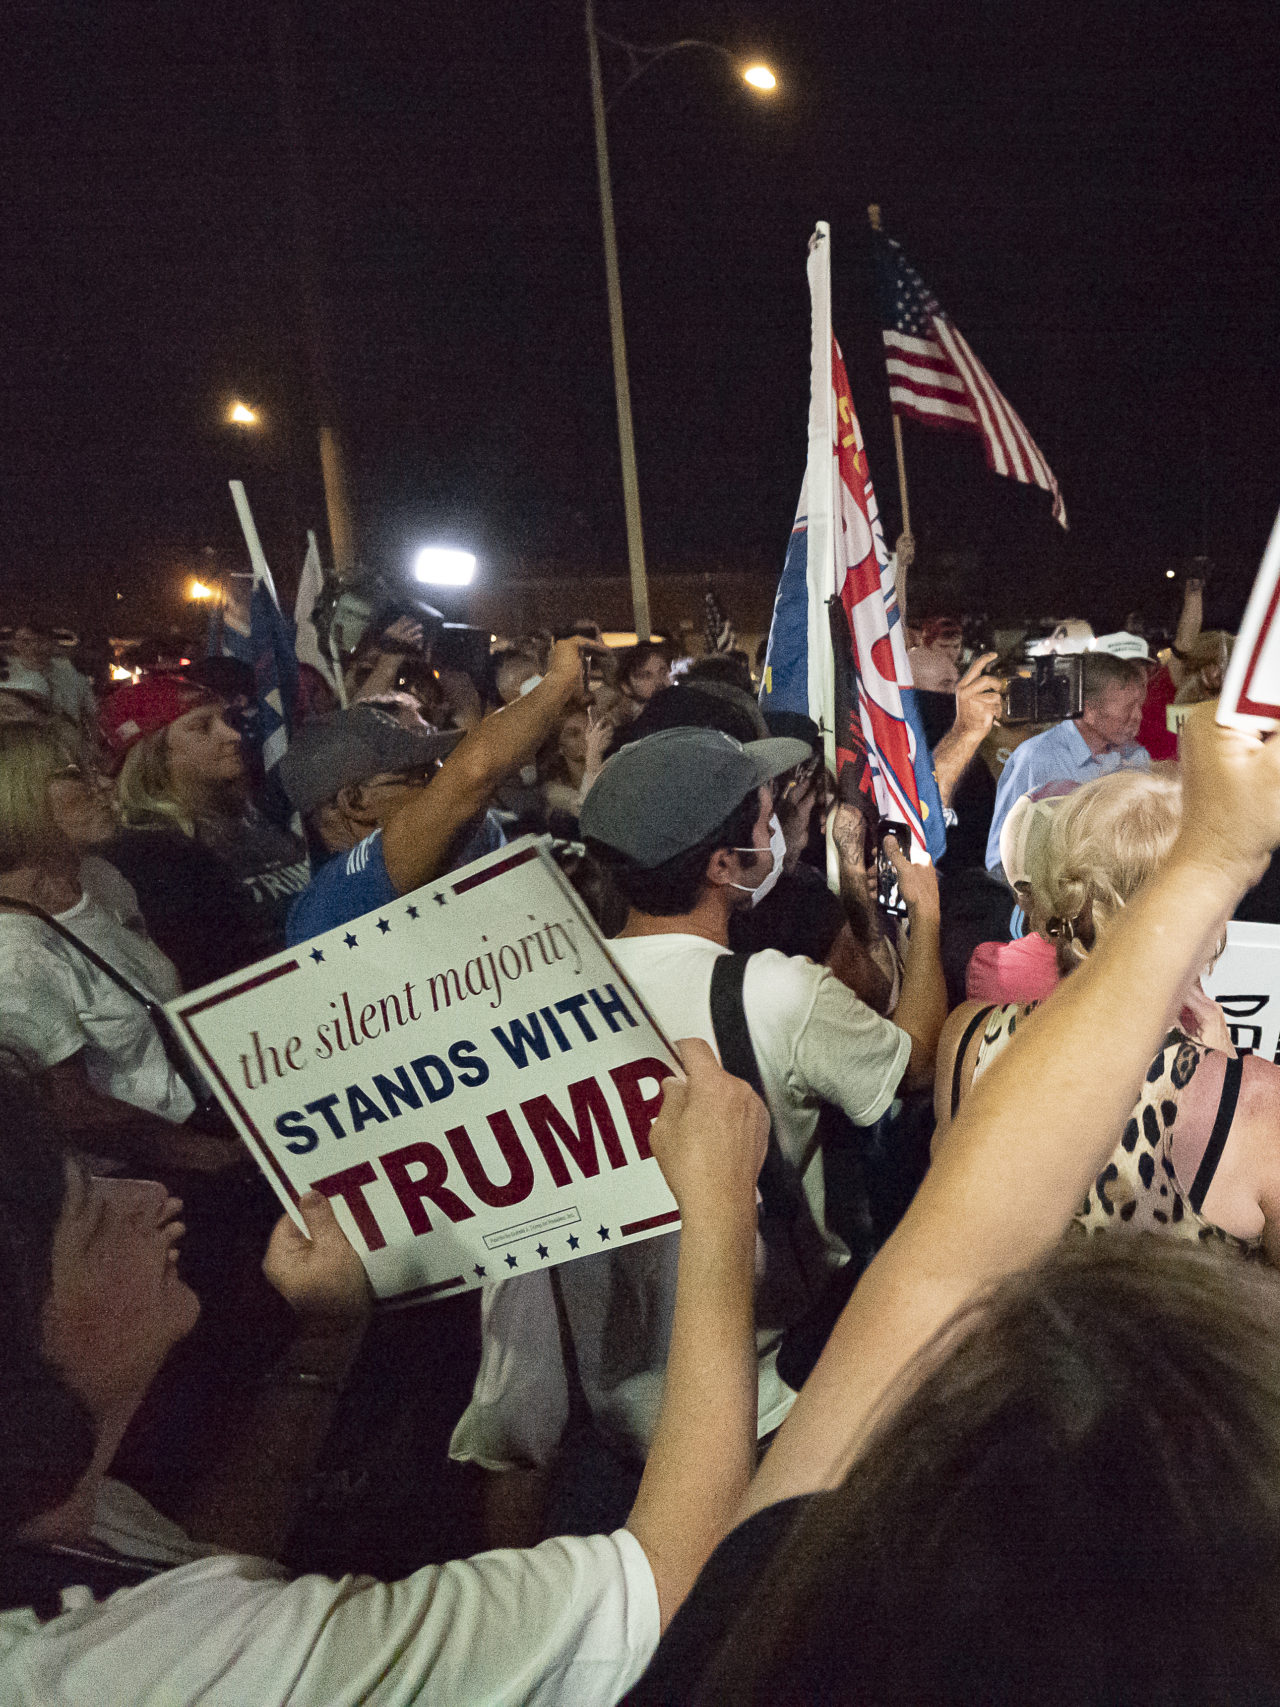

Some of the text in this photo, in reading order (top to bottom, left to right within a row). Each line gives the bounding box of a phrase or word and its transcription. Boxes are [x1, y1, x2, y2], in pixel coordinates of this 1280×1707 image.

[238, 914, 585, 1091] the silent majority
[273, 983, 640, 1156] STANDS WITH
[308, 1056, 678, 1253] TRUMP
